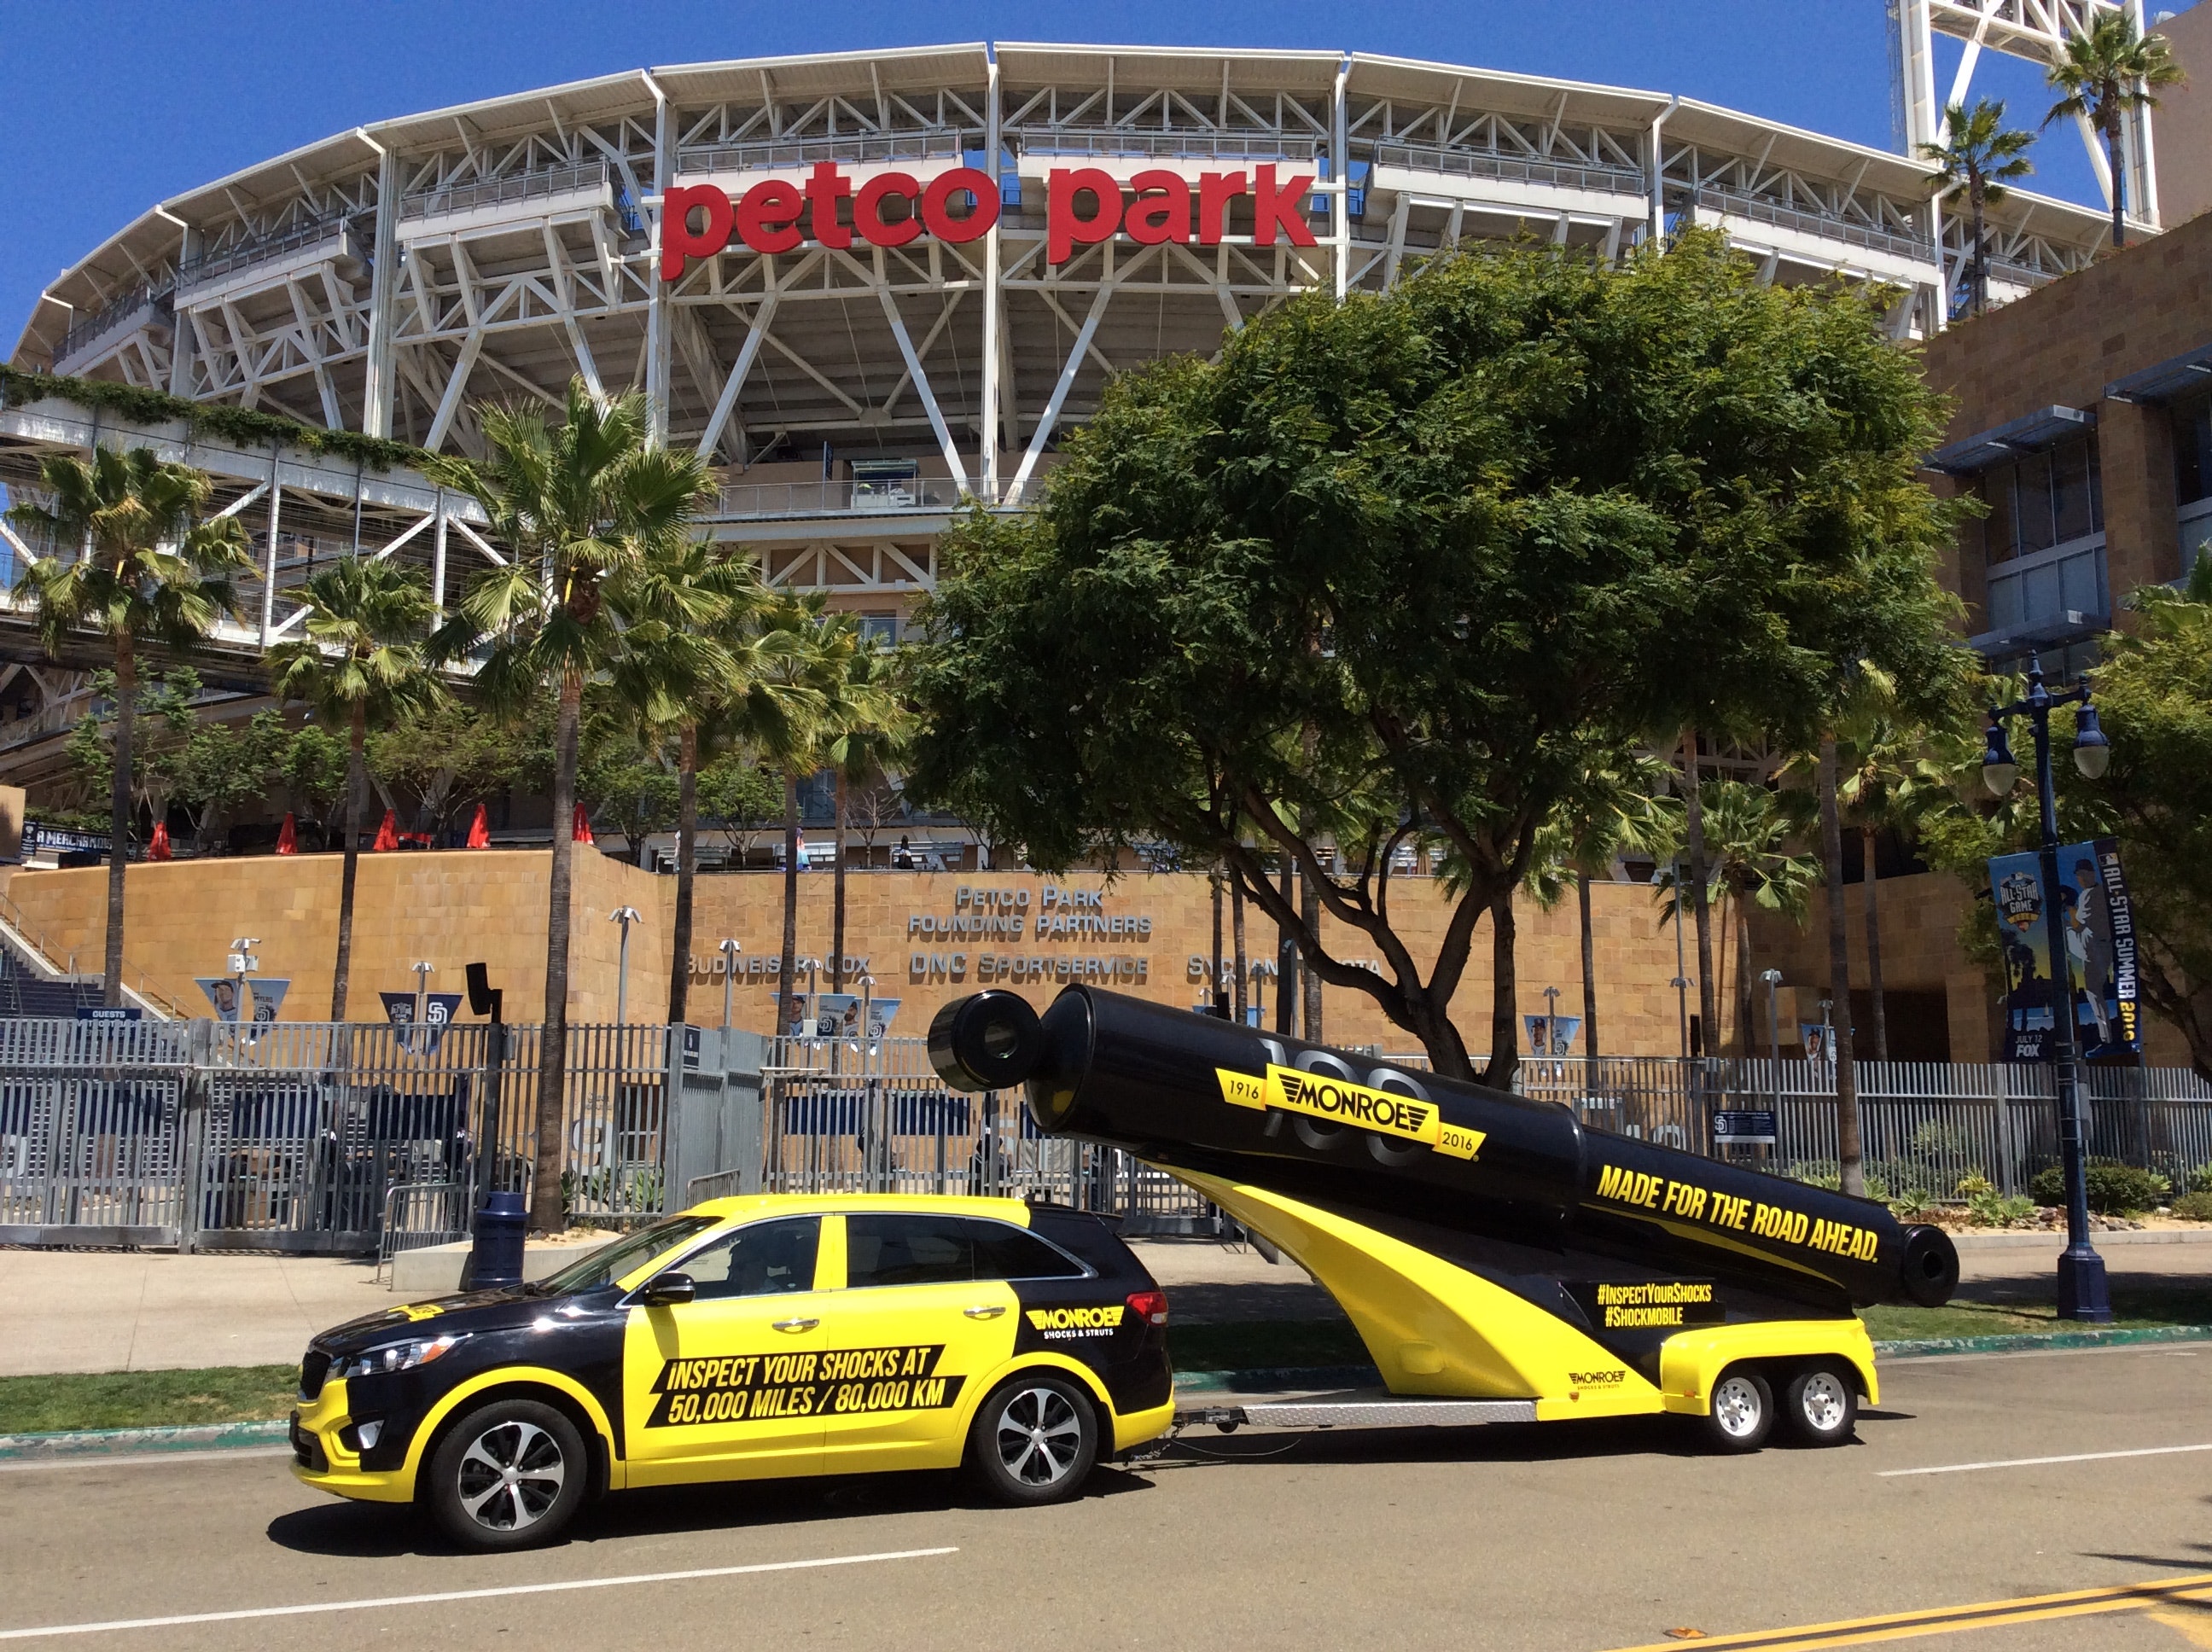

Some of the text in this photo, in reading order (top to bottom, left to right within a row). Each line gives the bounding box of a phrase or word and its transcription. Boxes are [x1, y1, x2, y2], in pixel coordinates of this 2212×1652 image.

[661, 161, 1318, 282] petco park
[2010, 900, 2033, 914] GAME
[909, 916, 1152, 934] FOUNDING PARTNERS
[688, 953, 810, 974] BUDWEISR
[911, 952, 966, 974] DNC
[2116, 937, 2136, 999] SUMMER
[2015, 1034, 2043, 1044] JULY 12
[2016, 1044, 2040, 1057] FOX
[1229, 1079, 1473, 1152] 1916 MONROE 2016
[1596, 1165, 1879, 1264] MADE FOR THE ROAD AHEAD.
[1042, 1307, 1113, 1329] MONROE
[1044, 1328, 1114, 1340] SHOCKS & STRUTS
[667, 1347, 931, 1391] INSPECT YOUR SHOCKS AT
[1576, 1370, 1620, 1384] MONROE
[667, 1376, 946, 1424] 50,000 MILES / 80,000 KM
